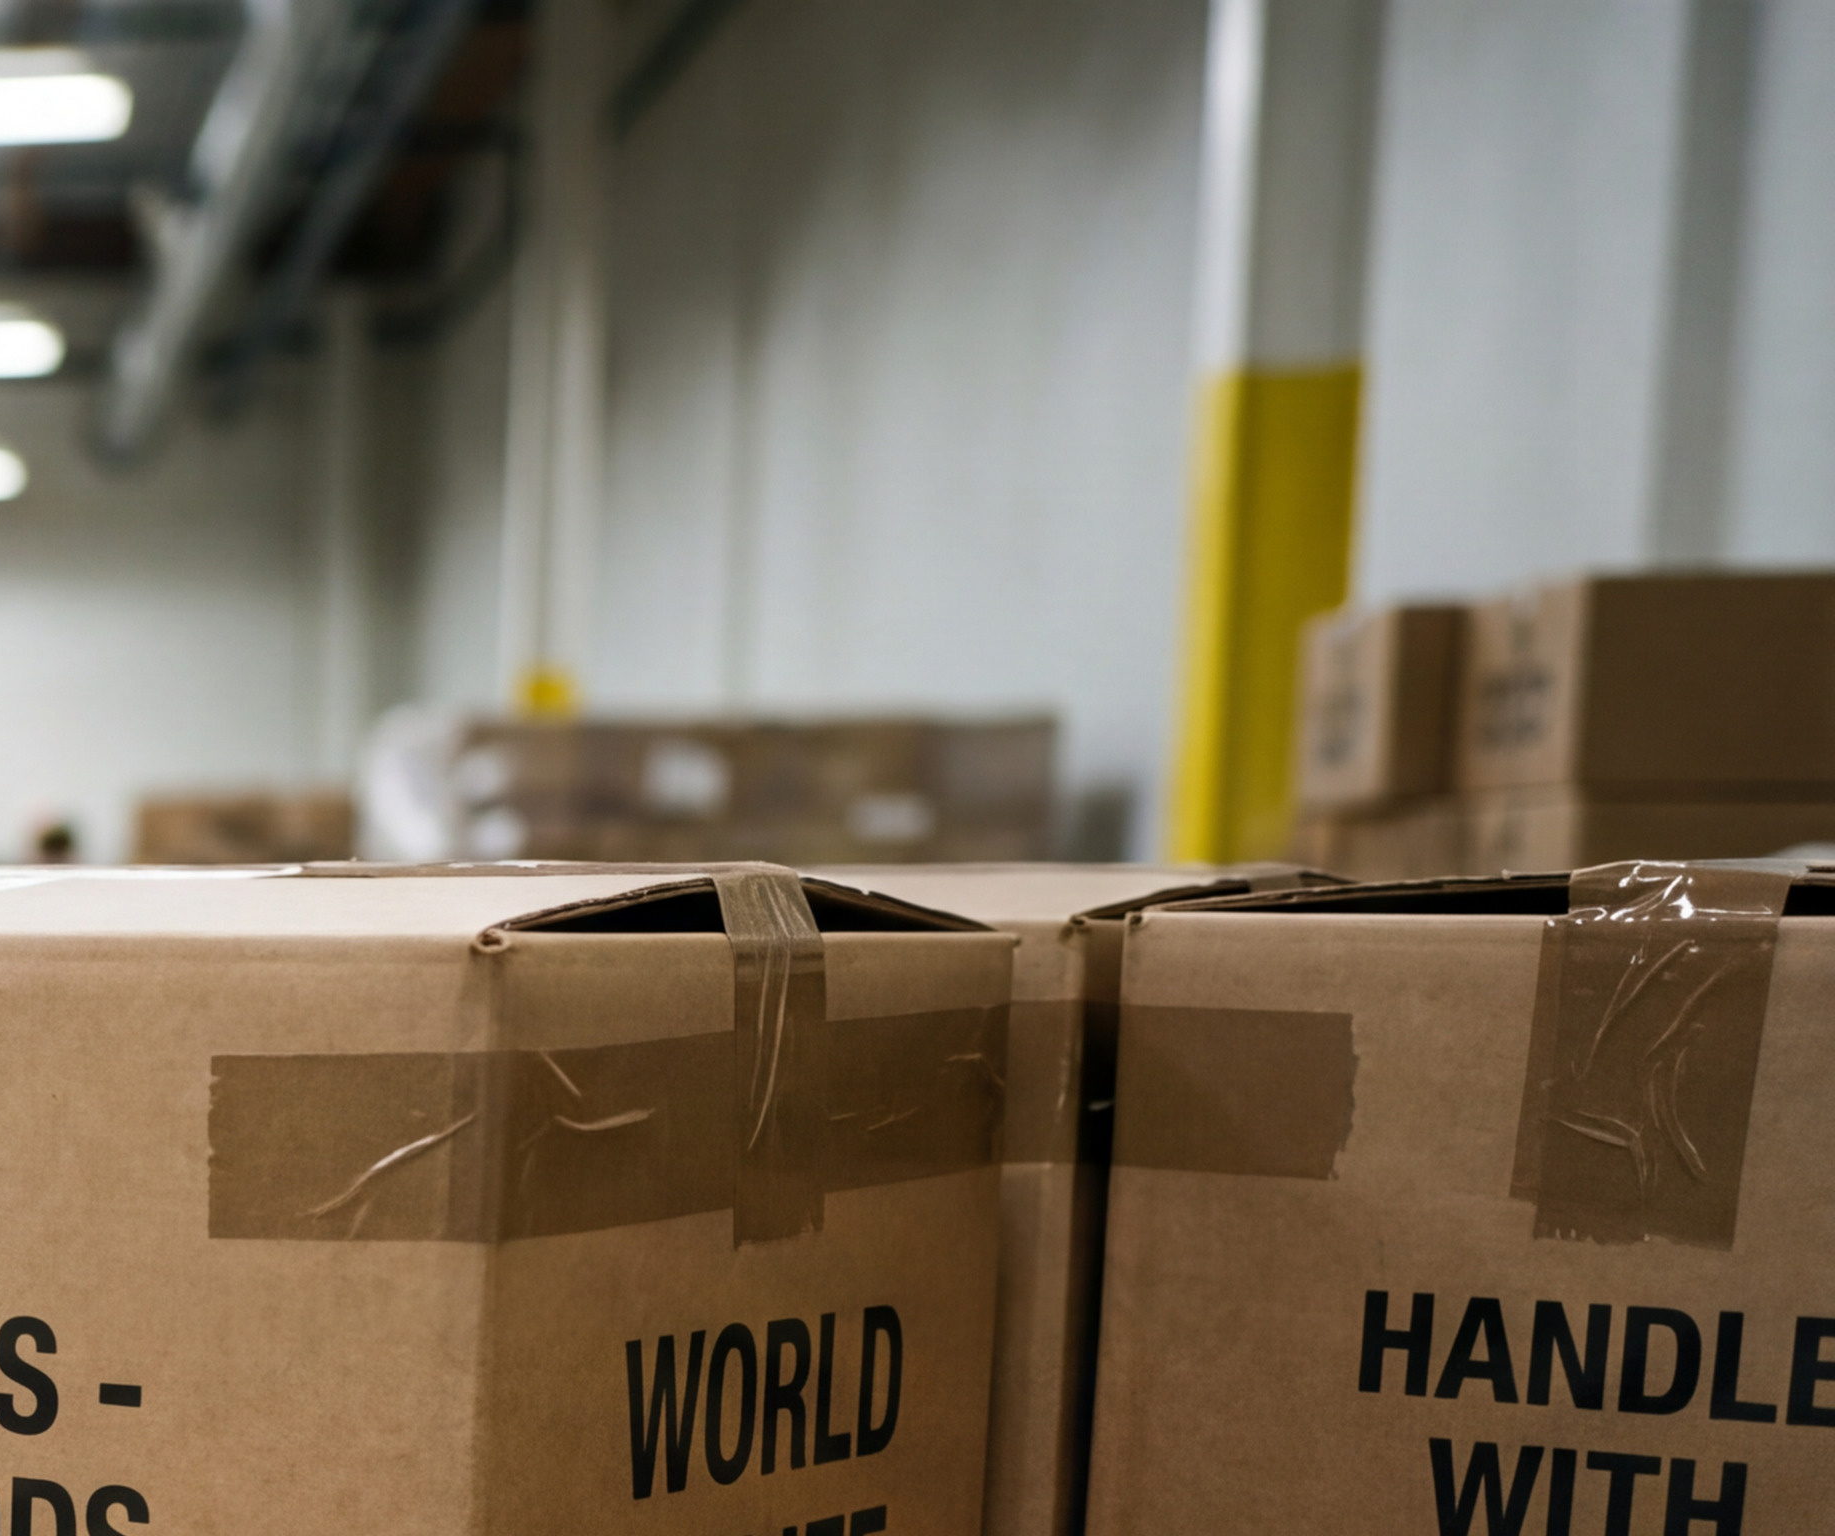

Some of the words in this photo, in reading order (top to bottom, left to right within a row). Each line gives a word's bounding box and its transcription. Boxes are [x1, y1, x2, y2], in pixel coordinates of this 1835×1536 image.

[98, 1382, 143, 1408] -
[624, 1305, 904, 1502] WORLD
[1358, 1289, 1835, 1428] HANDLE
